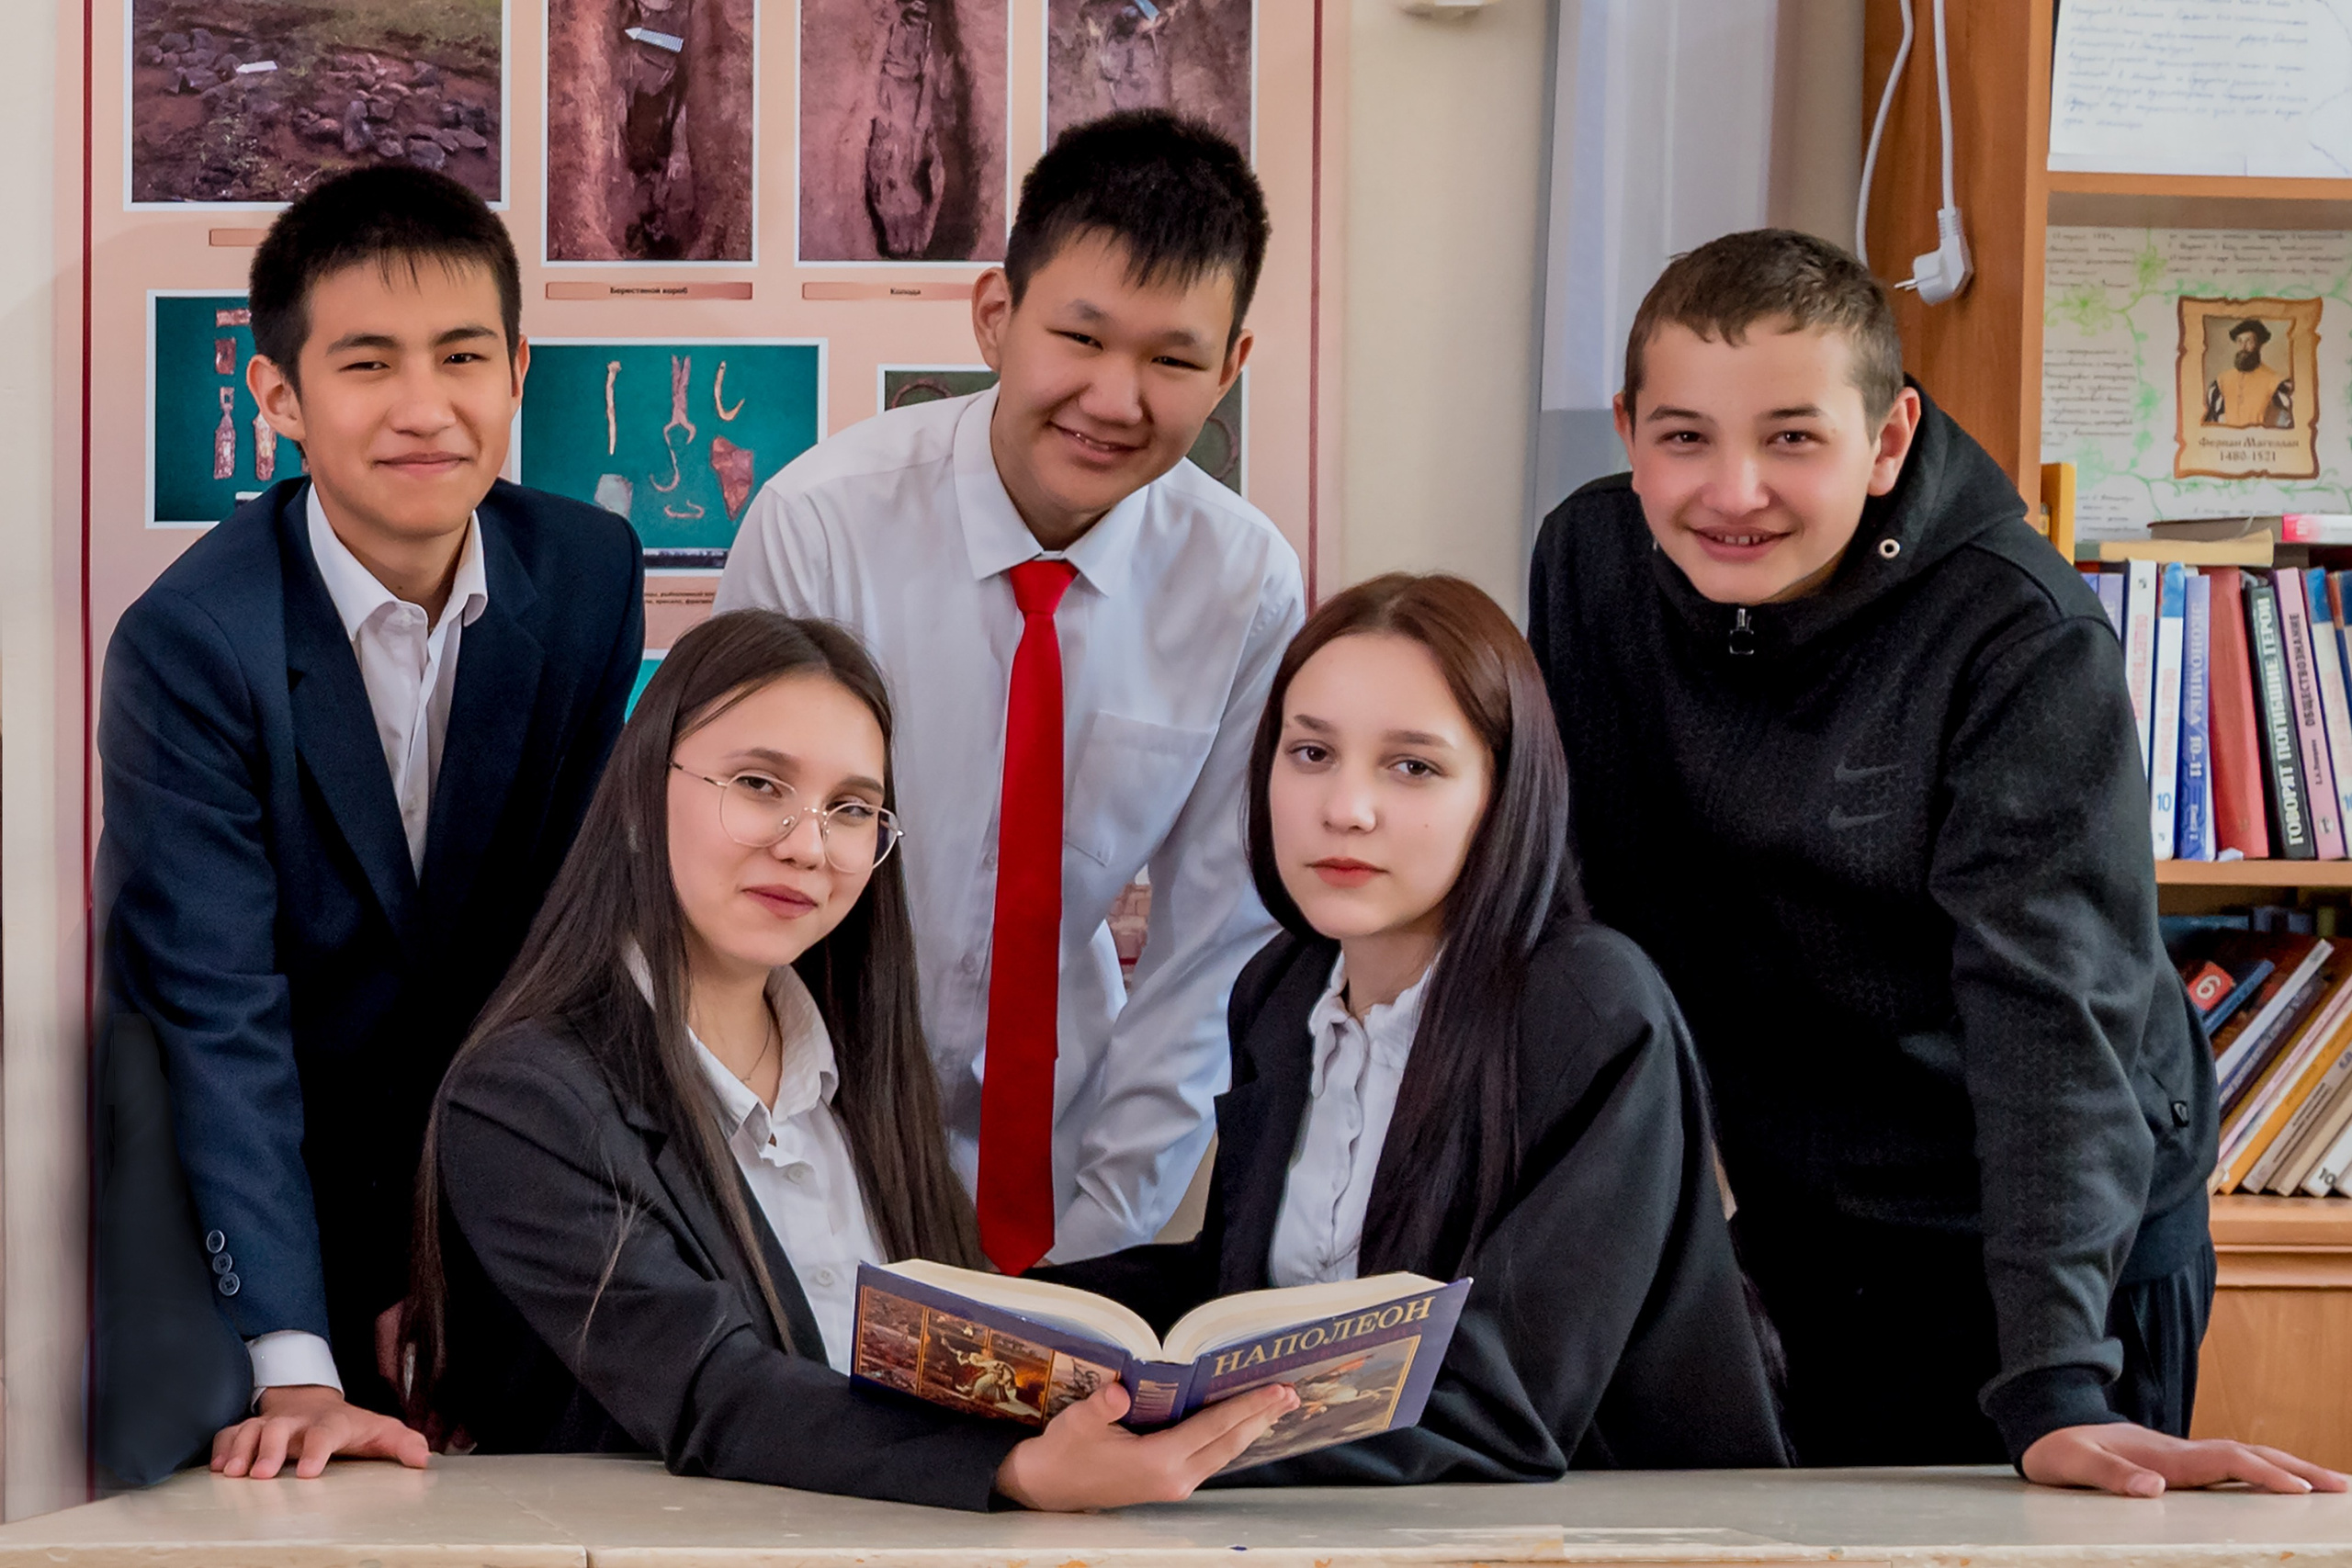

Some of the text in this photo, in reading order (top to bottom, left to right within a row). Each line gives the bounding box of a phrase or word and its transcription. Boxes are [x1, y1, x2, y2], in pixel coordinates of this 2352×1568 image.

[2256, 596, 2304, 845] ГОВОРЯТ ПОГИБШИЕ ГЕРОИ
[2156, 792, 2172, 812] 10
[2196, 975, 2222, 1000] 6
[1214, 1295, 1437, 1377] НАПОЛЕОН
